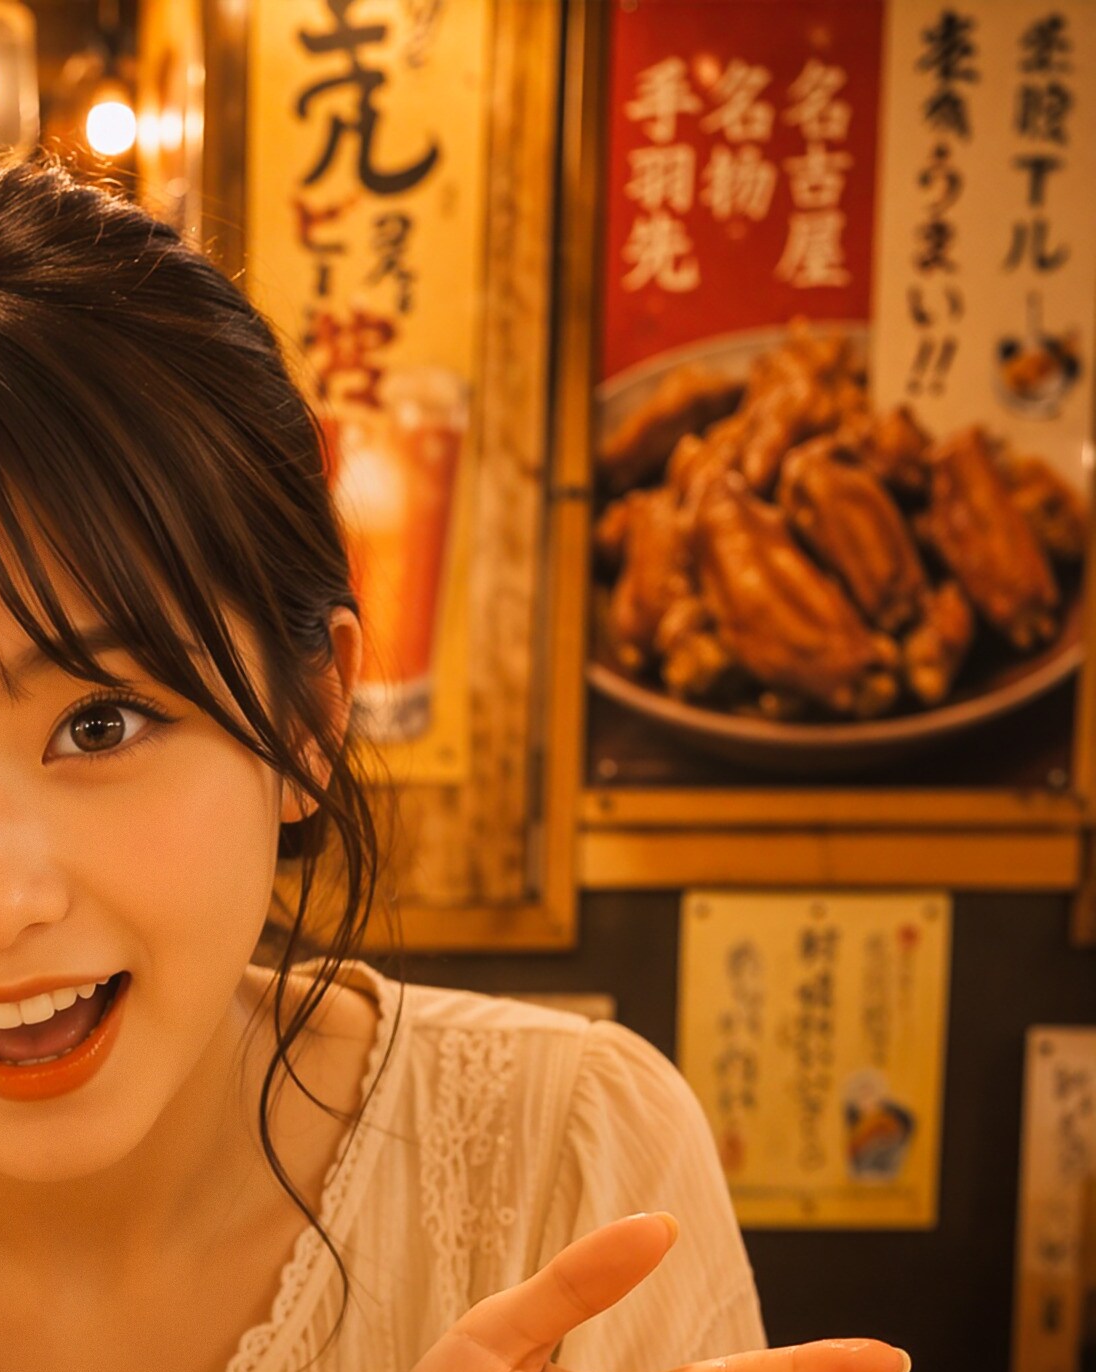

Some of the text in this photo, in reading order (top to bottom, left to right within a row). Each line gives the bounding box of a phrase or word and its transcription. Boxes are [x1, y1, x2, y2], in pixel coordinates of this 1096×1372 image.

[621, 56, 703, 293] 手羽先
[700, 58, 777, 221] 名物
[772, 58, 854, 289] 名古屋
